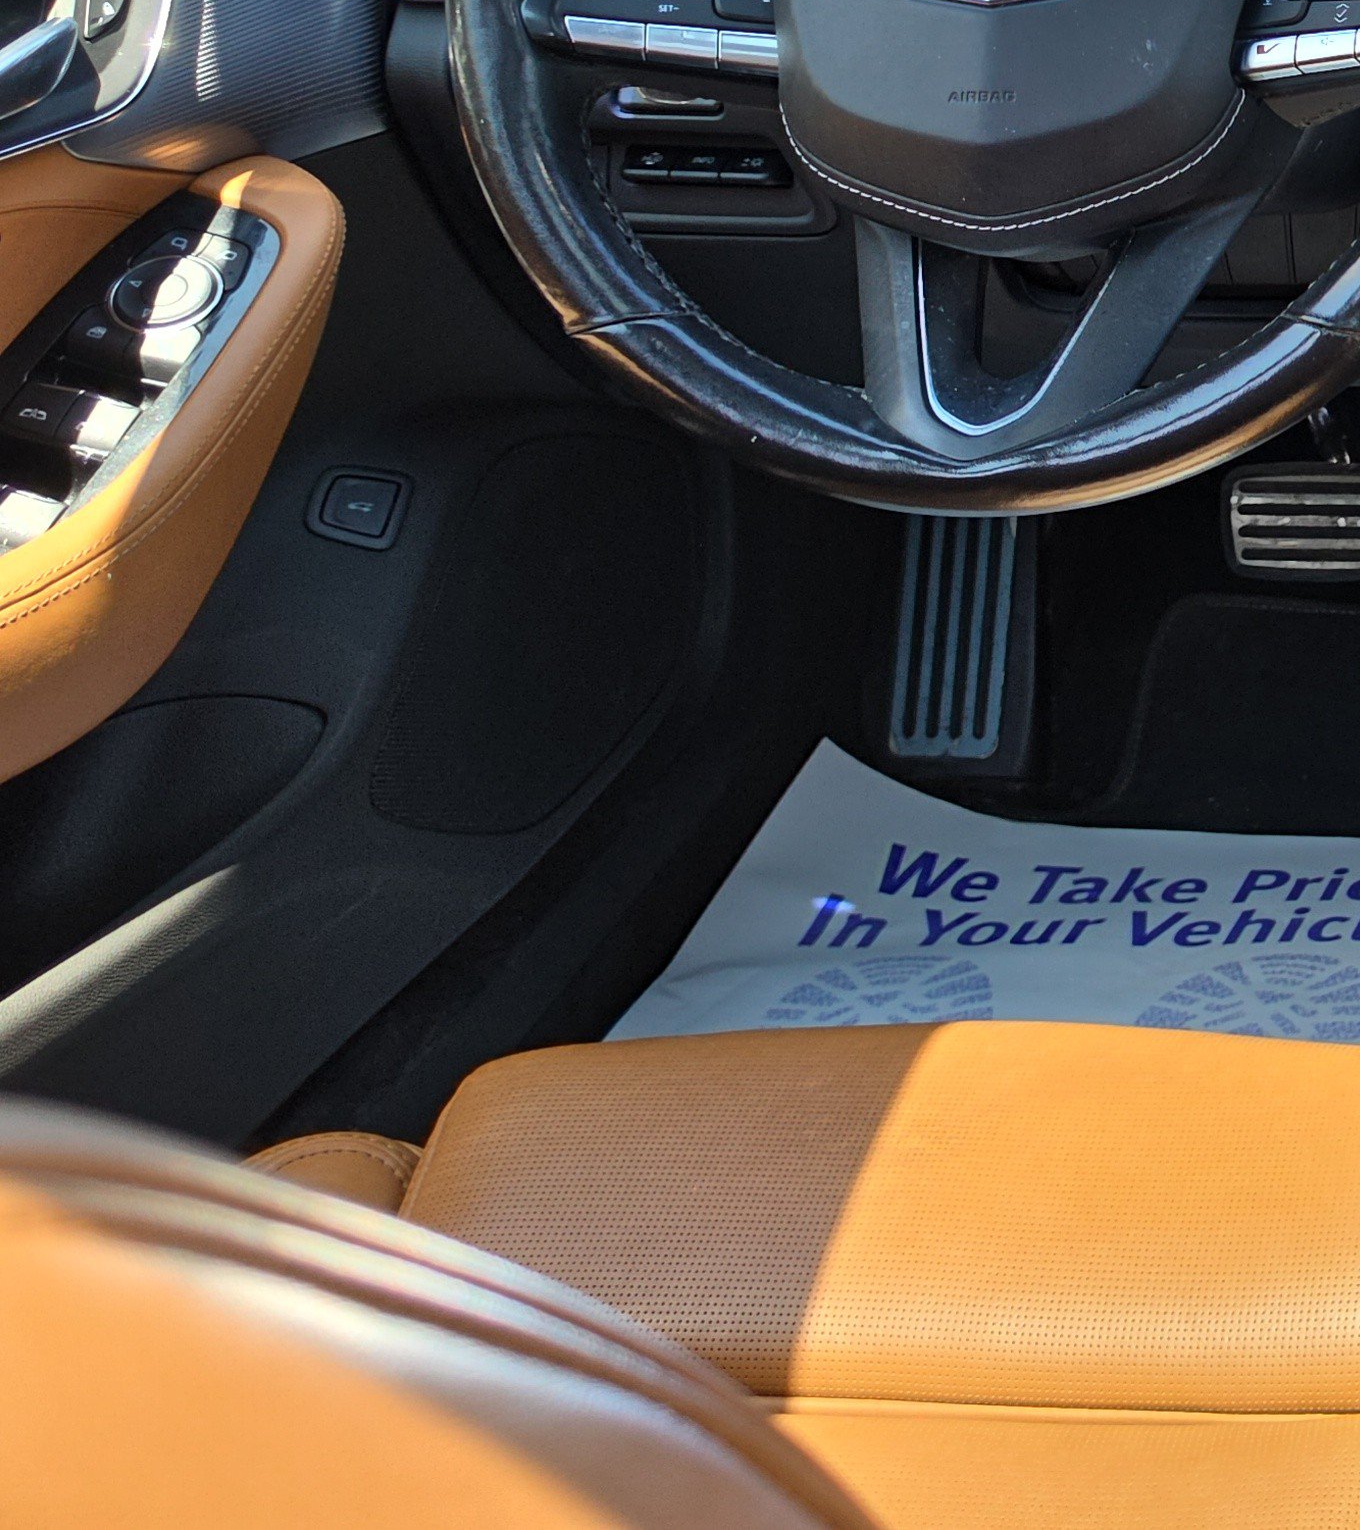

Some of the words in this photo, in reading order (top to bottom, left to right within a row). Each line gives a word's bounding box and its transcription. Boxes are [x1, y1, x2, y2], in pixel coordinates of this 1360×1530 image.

[948, 89, 1017, 104] AIRBAG
[879, 843, 999, 903] We
[1025, 864, 1209, 907] Take
[799, 893, 888, 950] In
[919, 909, 1105, 950] Your
